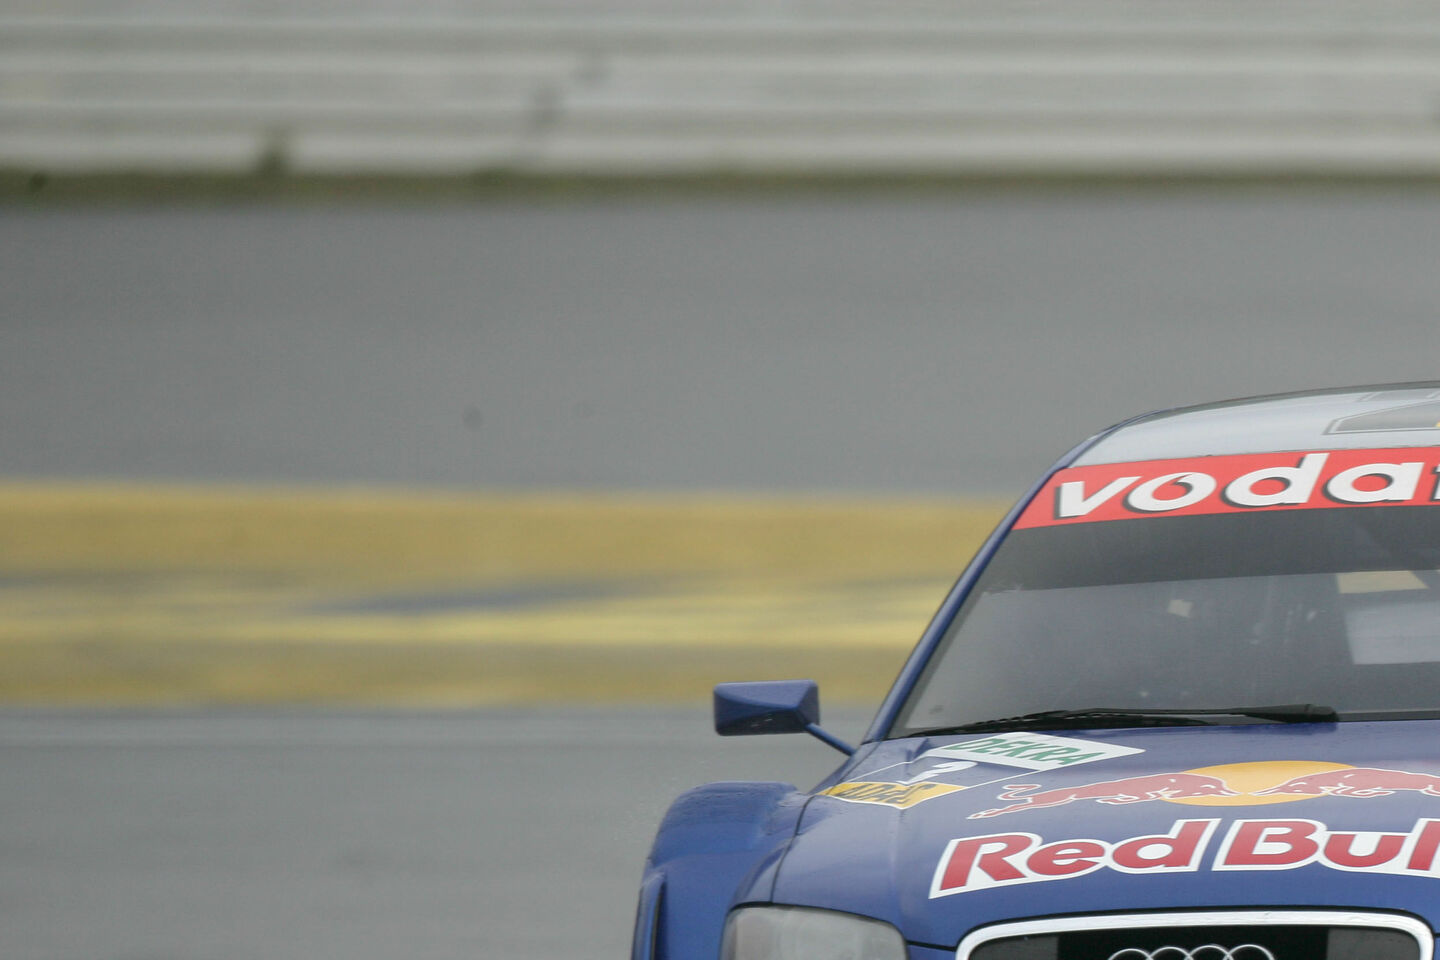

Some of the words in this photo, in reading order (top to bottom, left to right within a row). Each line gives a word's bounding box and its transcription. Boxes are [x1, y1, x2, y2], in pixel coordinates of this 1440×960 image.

[950, 737, 1106, 767] DEKRA
[895, 761, 979, 784] 2
[930, 818, 1221, 898] Red
